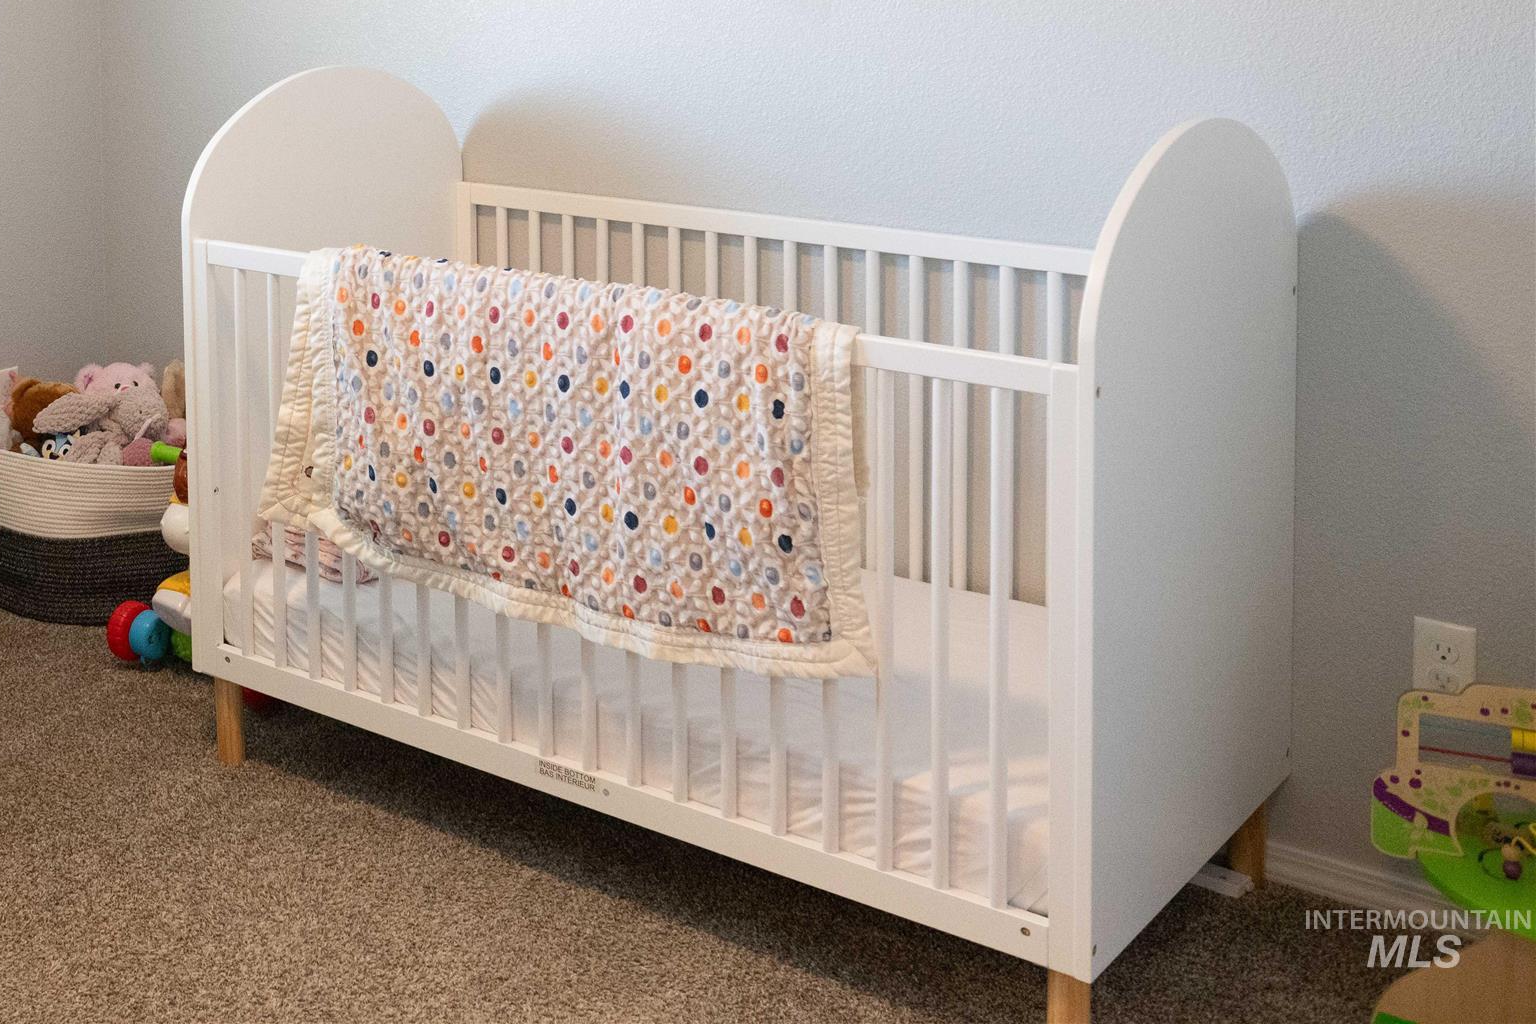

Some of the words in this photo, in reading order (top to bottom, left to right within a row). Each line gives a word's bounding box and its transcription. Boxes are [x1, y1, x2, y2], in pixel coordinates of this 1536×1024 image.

[538, 760, 563, 773] INSIDE
[564, 768, 596, 784] BOTTOM
[539, 768, 554, 778] BAS
